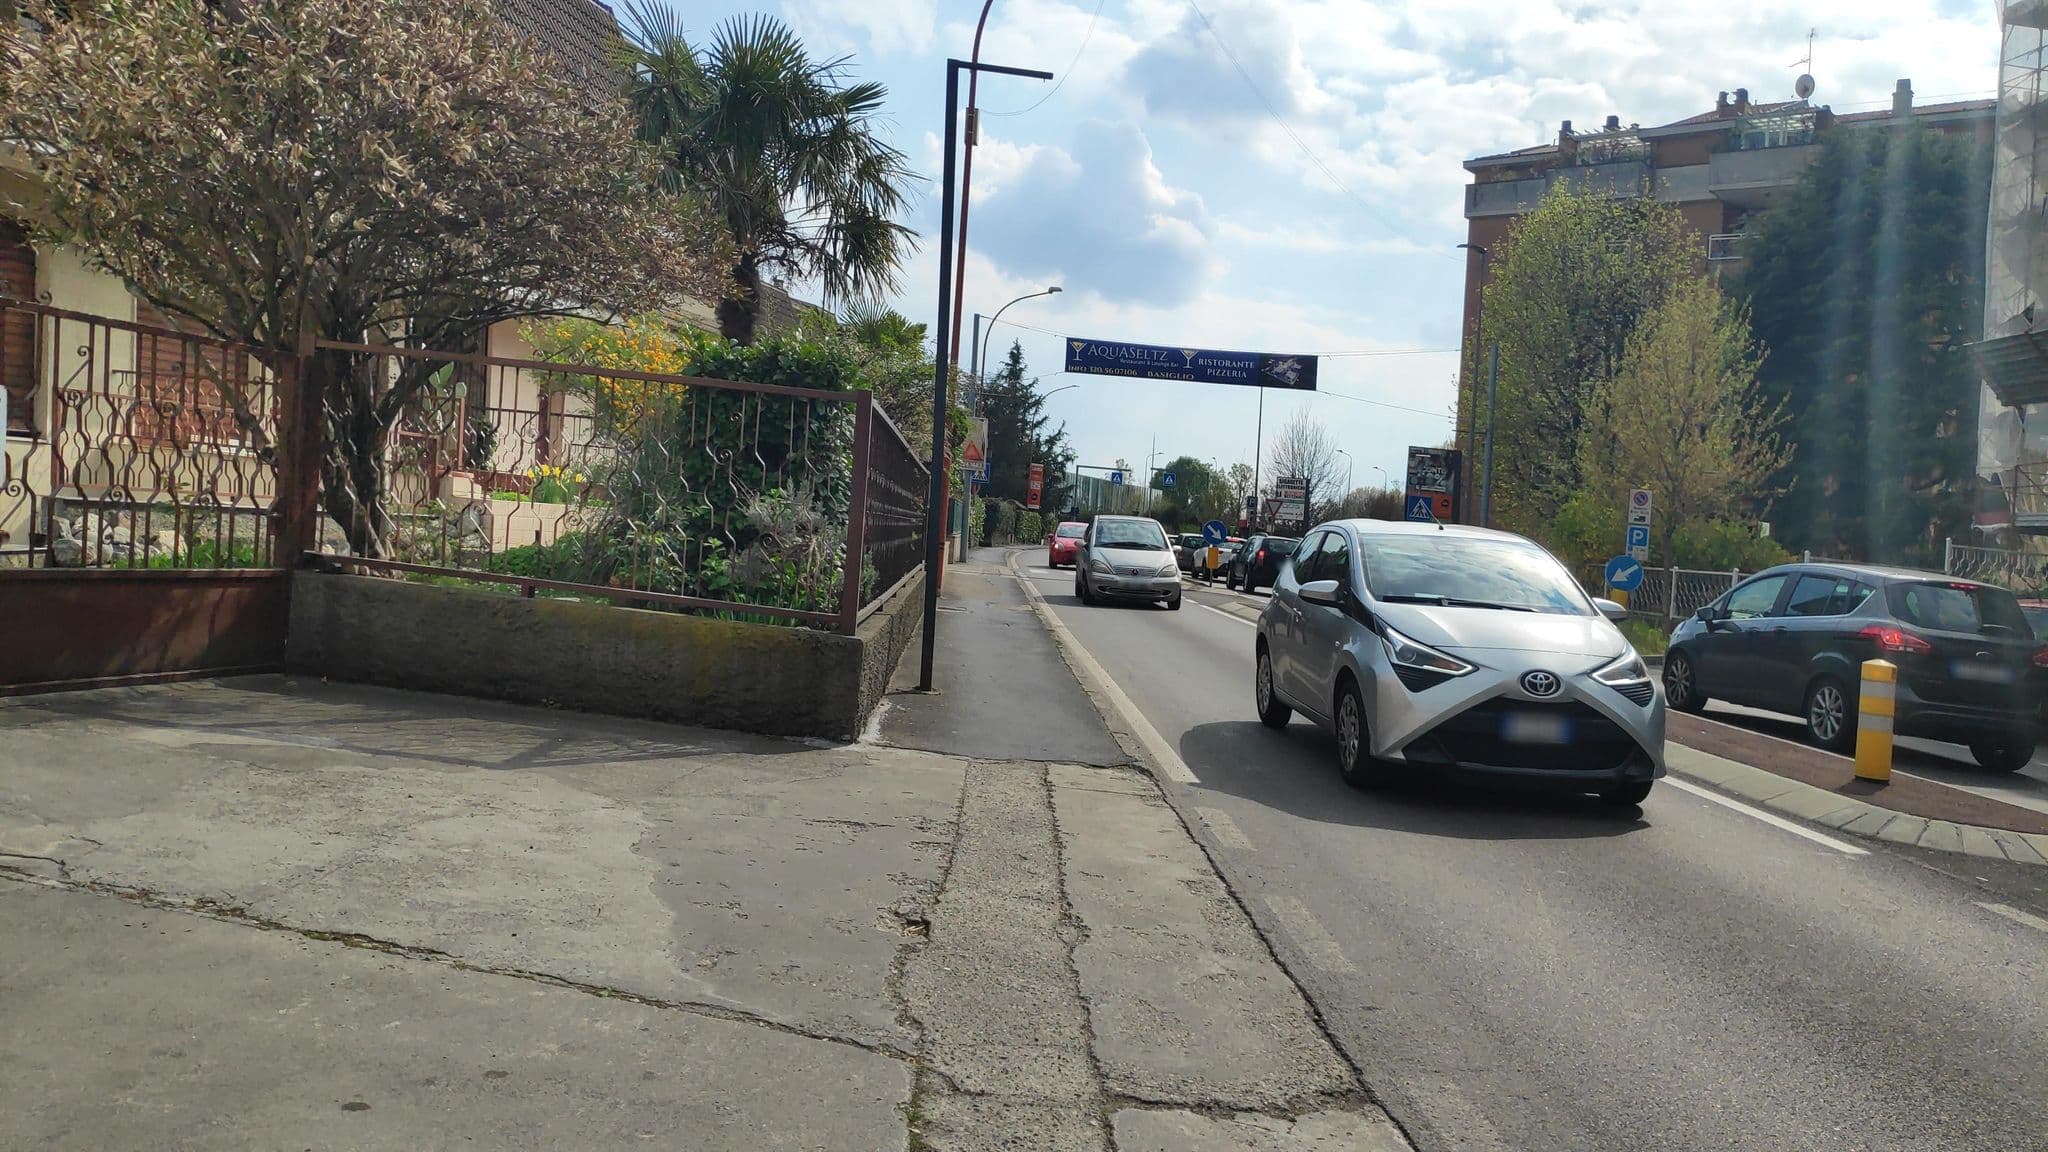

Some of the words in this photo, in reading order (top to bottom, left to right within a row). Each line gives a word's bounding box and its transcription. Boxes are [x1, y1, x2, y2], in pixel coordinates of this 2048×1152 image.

[1198, 358, 1255, 369] RISTORANTE
[1147, 370, 1194, 380] BASIGLIO
[1207, 368, 1247, 378] PIZZERIA
[1633, 530, 1643, 543] P
